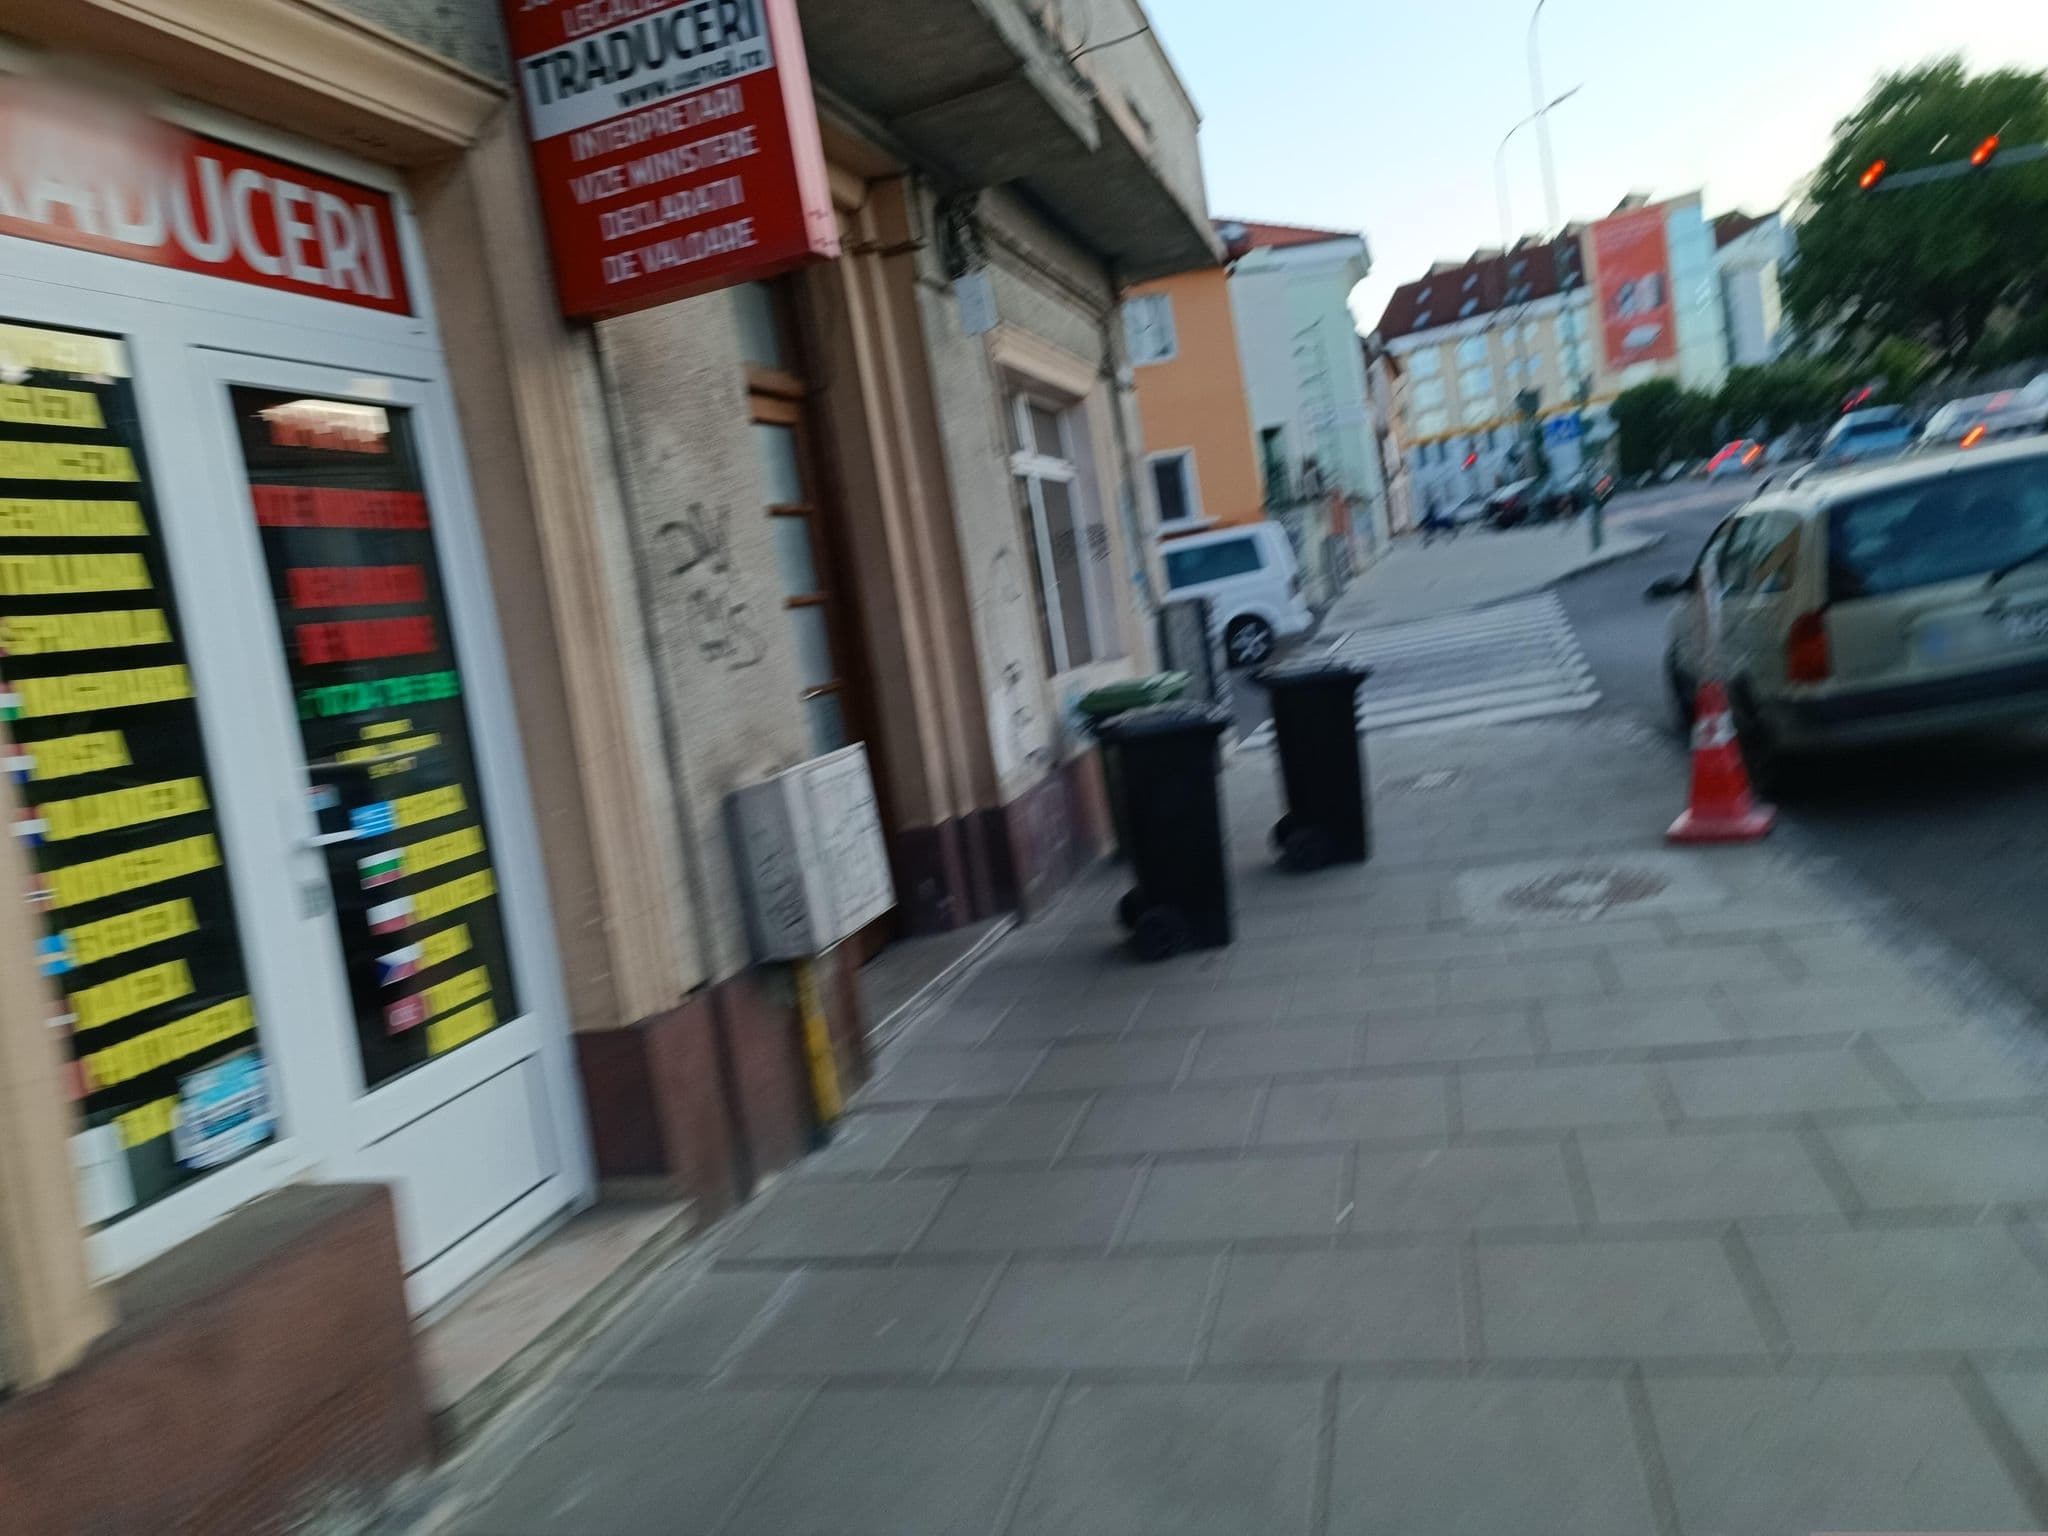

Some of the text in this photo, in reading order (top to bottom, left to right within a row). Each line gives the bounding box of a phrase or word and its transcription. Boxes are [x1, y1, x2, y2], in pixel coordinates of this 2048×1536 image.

[525, 0, 761, 105] TRADUCERI
[569, 124, 760, 204] VIZE MINISTERE
[0, 125, 393, 299] ADUCERI
[602, 216, 759, 285] DE VALOARE
